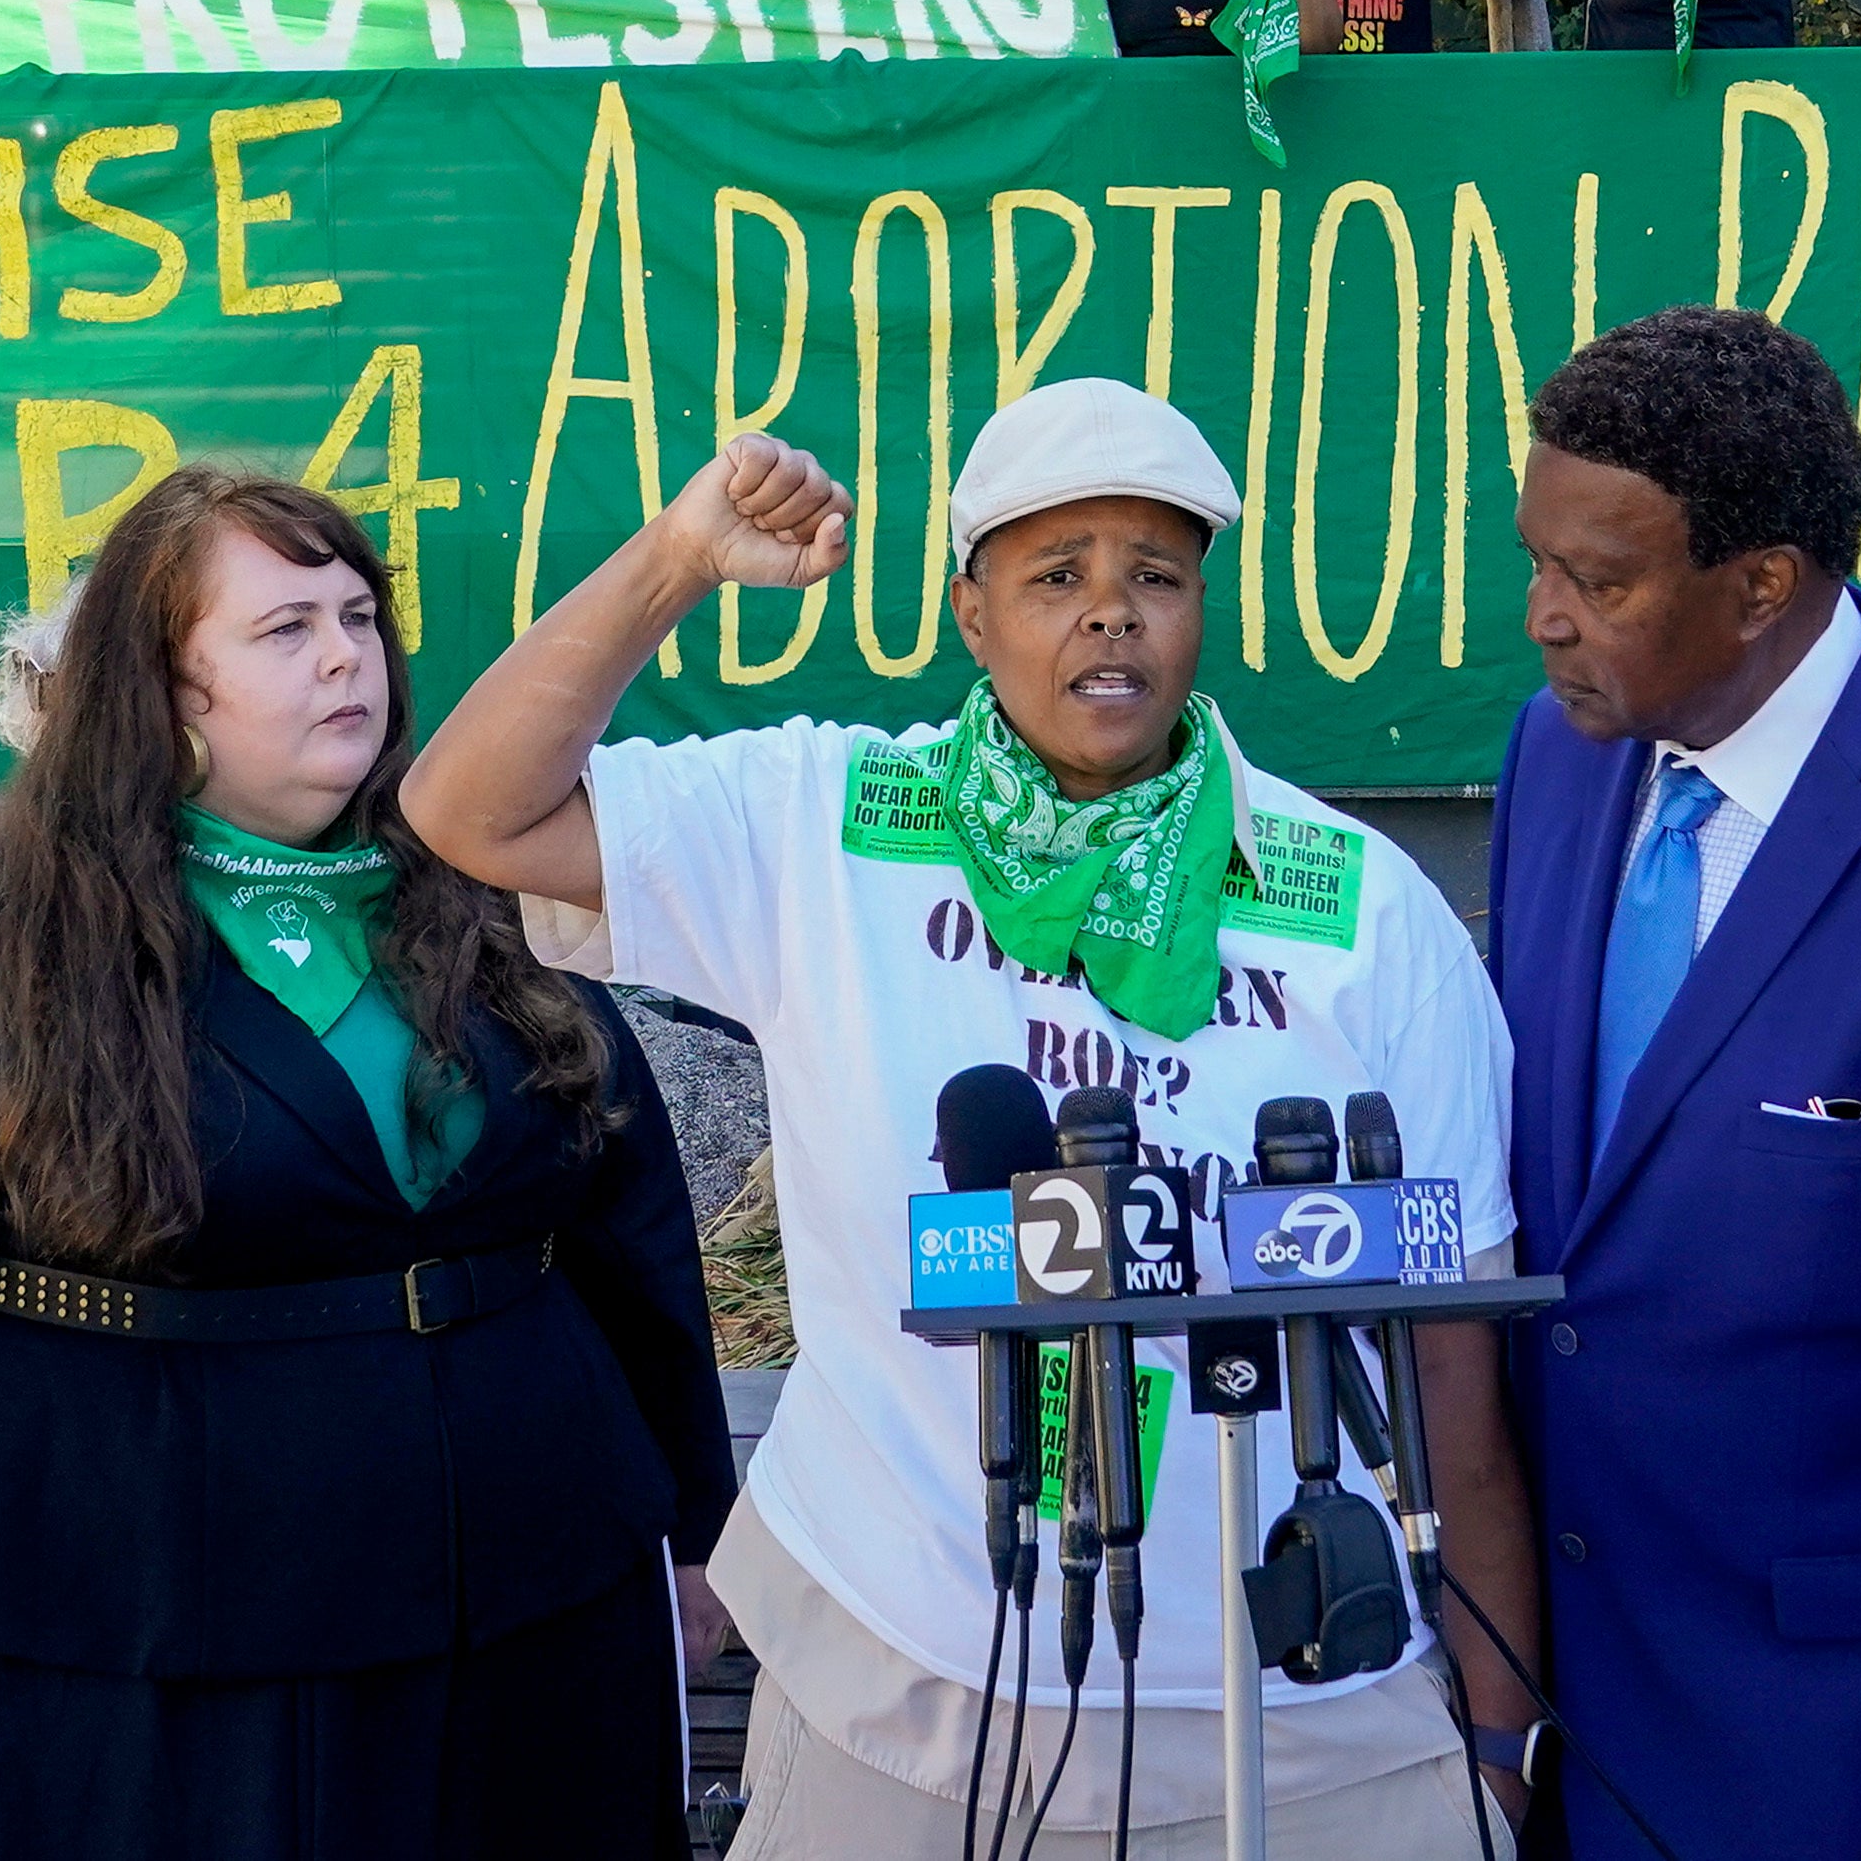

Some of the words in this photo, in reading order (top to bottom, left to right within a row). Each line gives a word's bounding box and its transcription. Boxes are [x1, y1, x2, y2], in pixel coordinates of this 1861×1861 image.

[293, 342, 461, 656] 4
[863, 740, 921, 765] RISE
[858, 758, 925, 780] Abortion
[860, 780, 913, 808] WEAR
[852, 802, 884, 827] for
[1288, 821, 1322, 848] UP
[1329, 831, 1348, 855] 4
[1291, 847, 1347, 871] Rights!
[1280, 865, 1341, 895] GREEN
[1251, 884, 1340, 917] Abortion
[1414, 1184, 1457, 1199] NEWS
[1121, 1173, 1181, 1262] 2
[1018, 1177, 1103, 1296] 2
[920, 1257, 960, 1276] BAY
[967, 1254, 1015, 1272] ARE
[1253, 1239, 1303, 1265] abc
[1403, 1244, 1462, 1269] ADIO
[1124, 1261, 1184, 1292] KTVU
